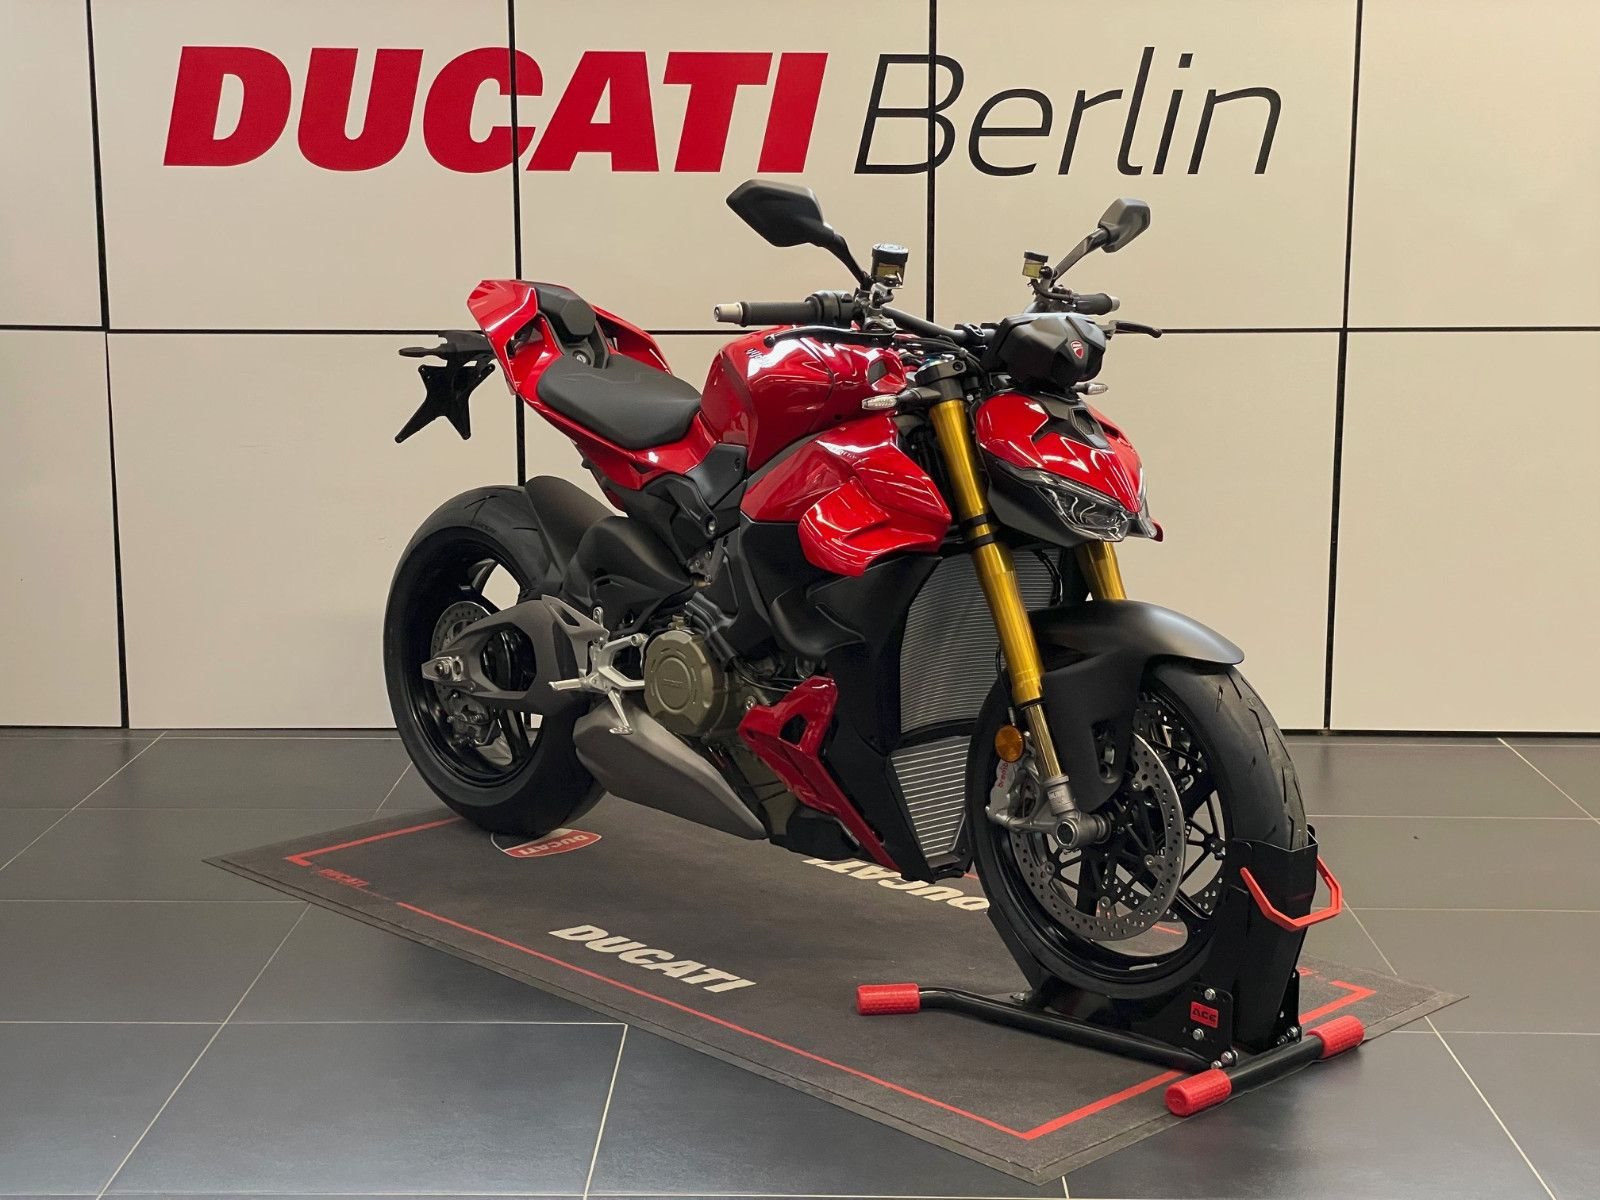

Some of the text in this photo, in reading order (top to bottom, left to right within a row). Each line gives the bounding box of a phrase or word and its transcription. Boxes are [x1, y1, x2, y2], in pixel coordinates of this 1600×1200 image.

[164, 46, 1281, 176] DUCATI Berlin
[517, 834, 590, 856] DUCATI
[803, 858, 990, 912] DUCATI
[548, 924, 757, 993] DUCATI
